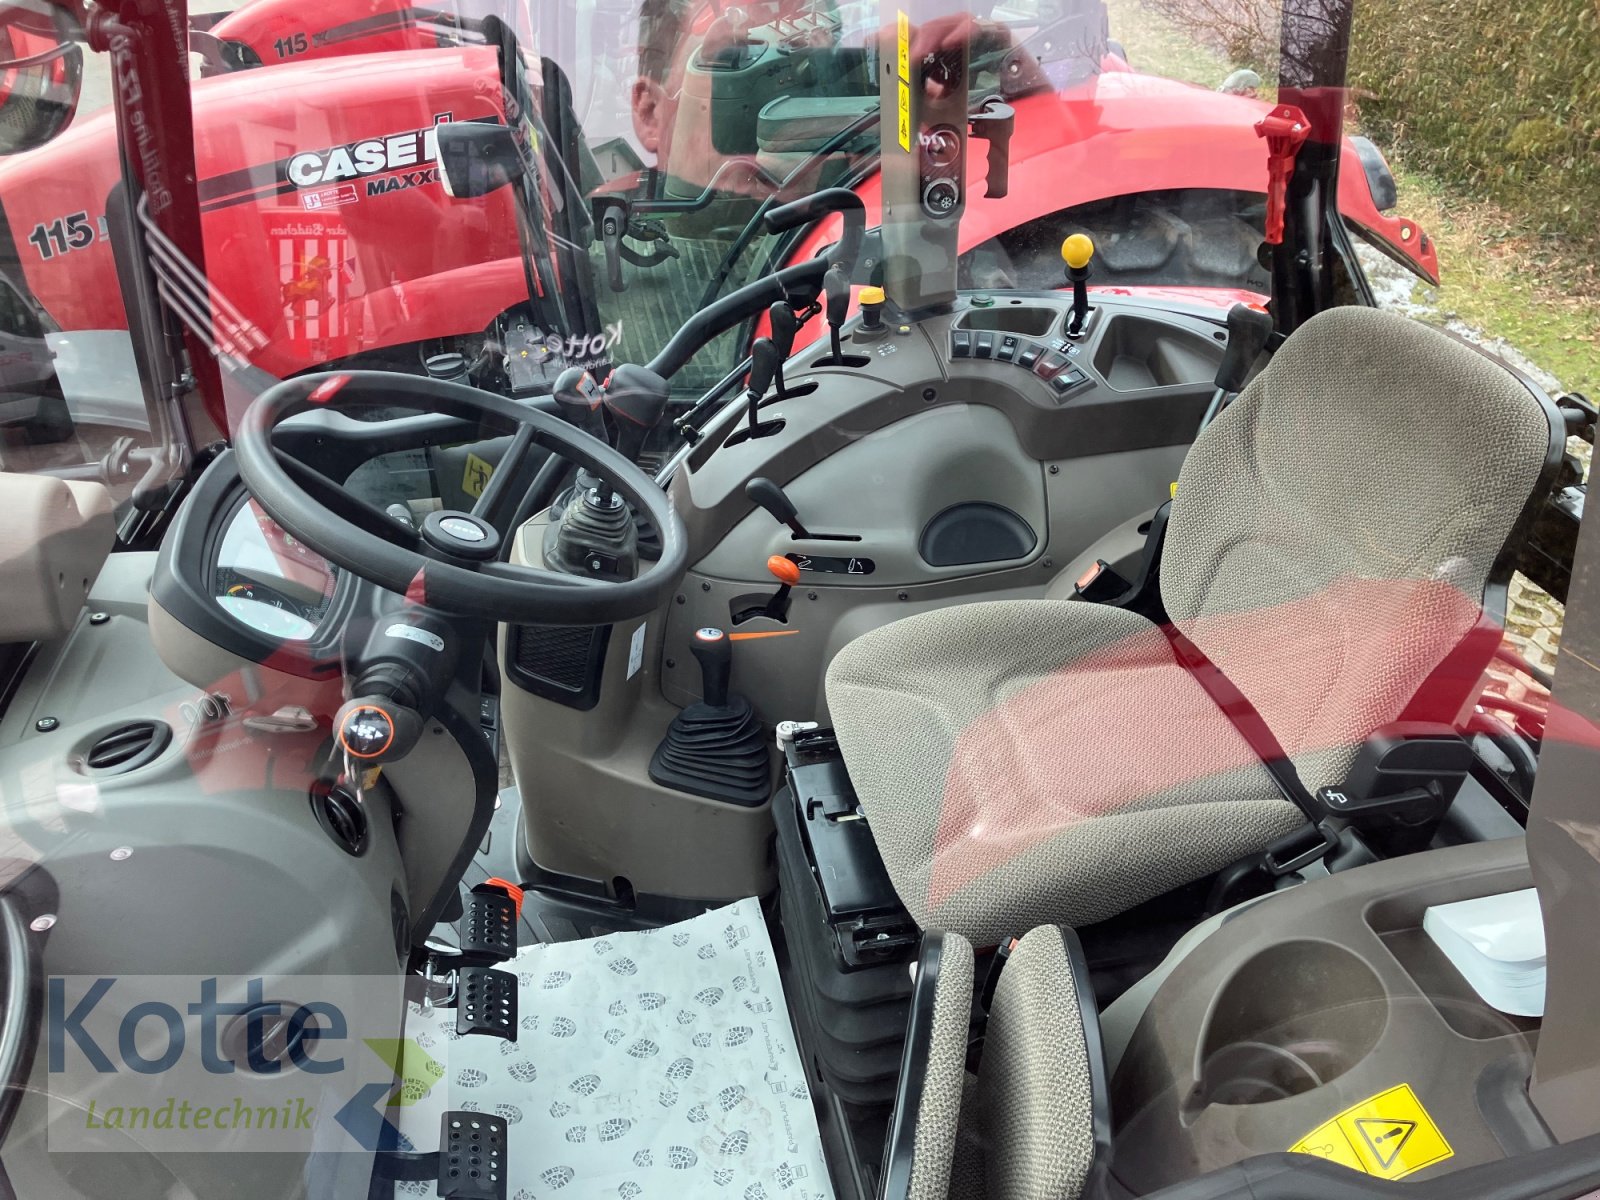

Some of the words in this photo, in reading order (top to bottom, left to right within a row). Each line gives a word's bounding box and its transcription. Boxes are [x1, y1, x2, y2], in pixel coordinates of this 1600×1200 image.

[273, 32, 310, 58] 115
[288, 133, 418, 186] CASE
[28, 209, 95, 261] 115
